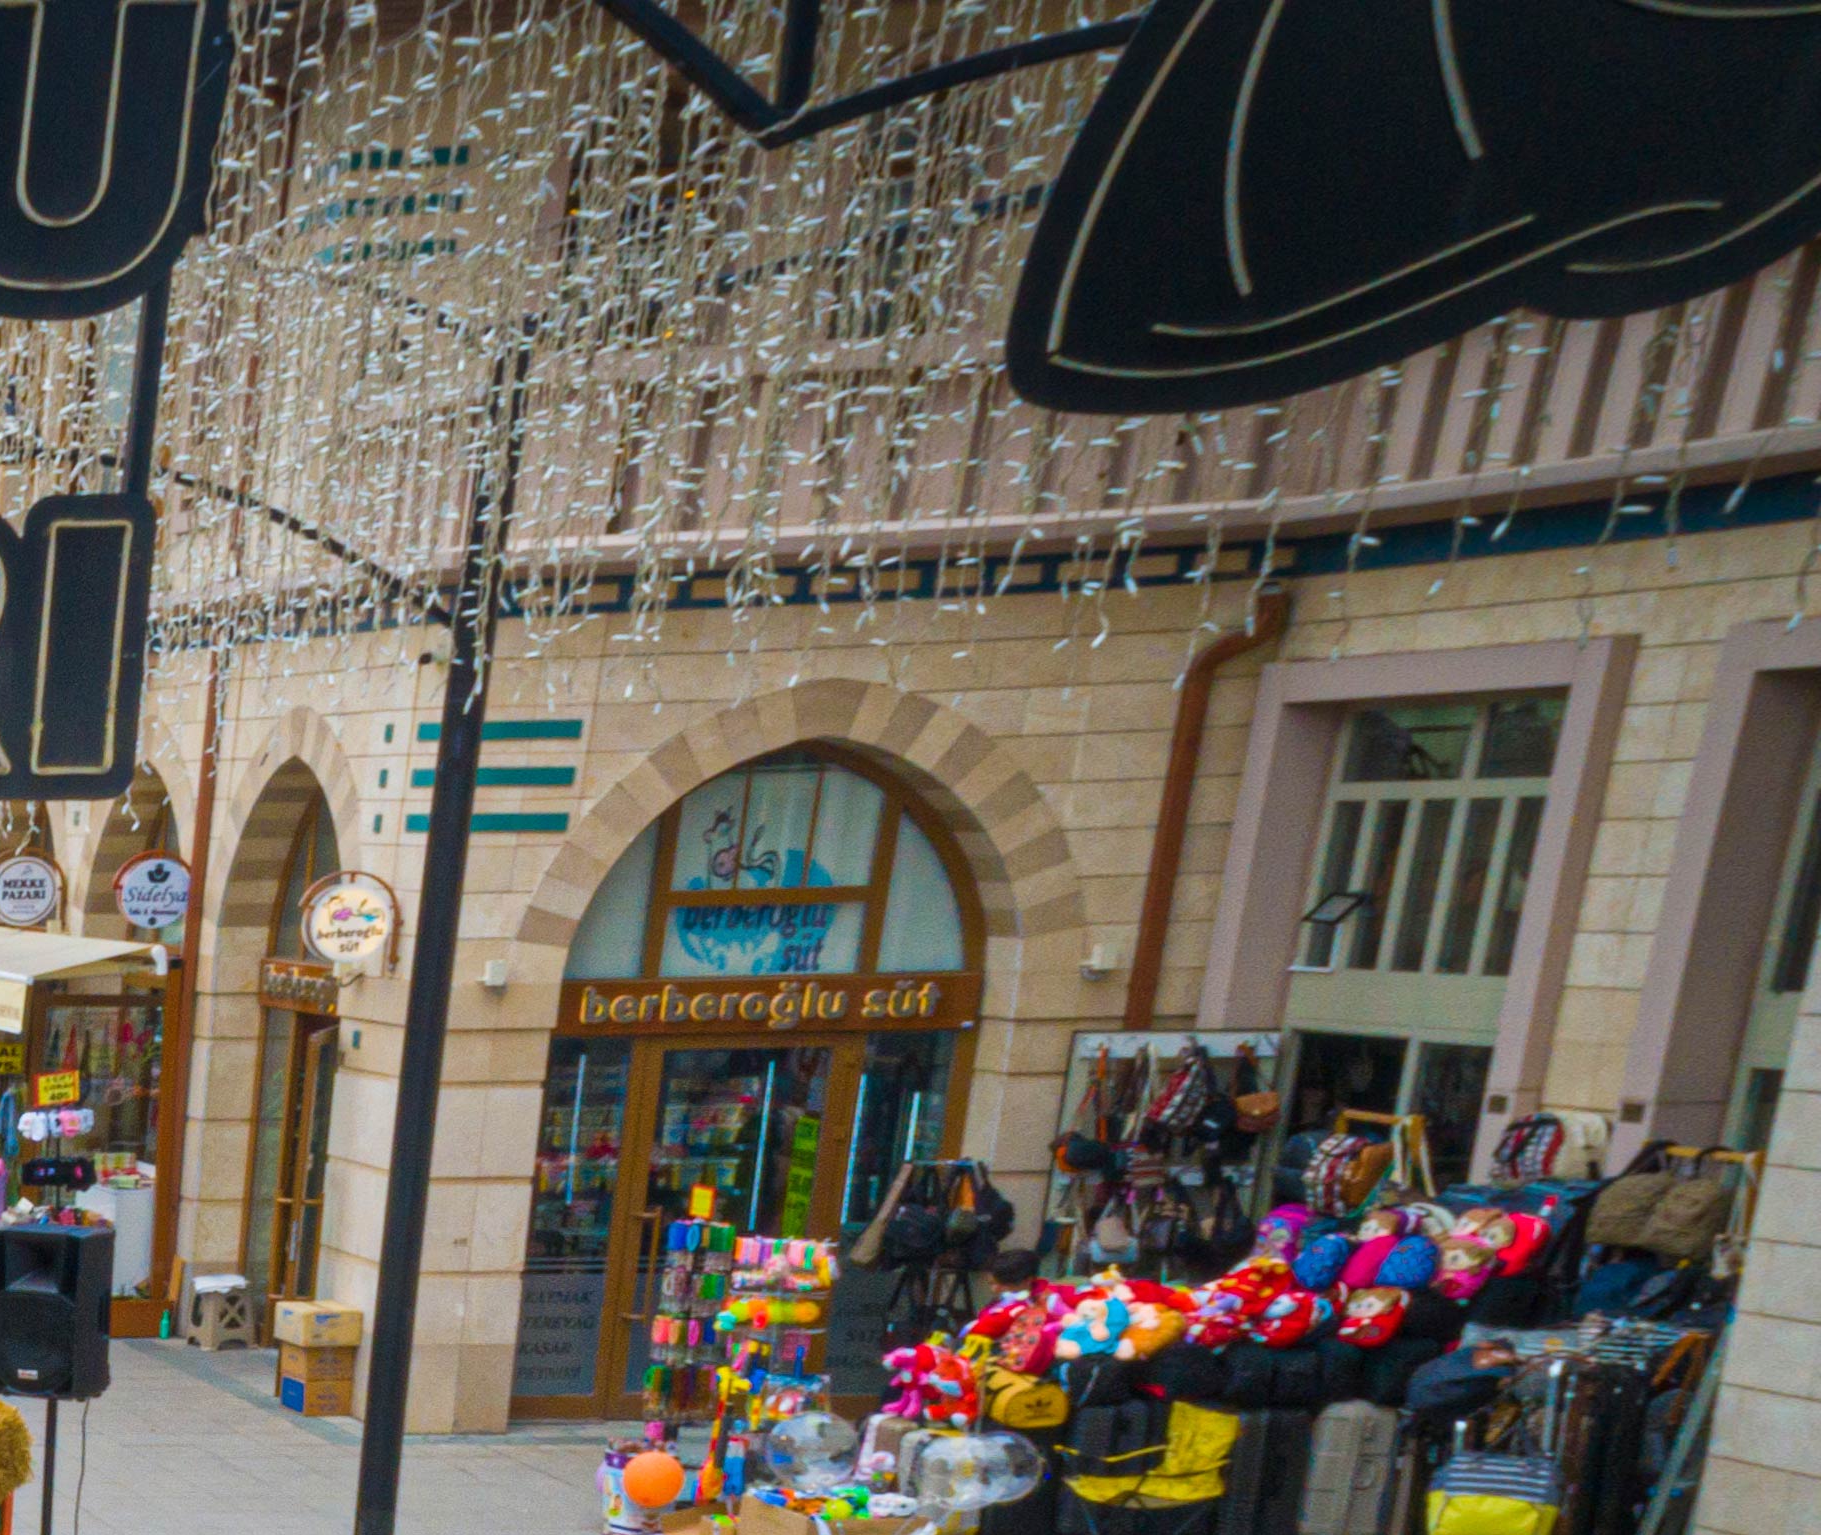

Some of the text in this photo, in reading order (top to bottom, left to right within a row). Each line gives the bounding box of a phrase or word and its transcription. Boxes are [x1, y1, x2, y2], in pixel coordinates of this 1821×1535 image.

[3, 878, 46, 889] MEKKE
[2, 889, 46, 901] PAZARI
[124, 885, 188, 907] Sidelya
[579, 980, 941, 1030] berberoğlu süt
